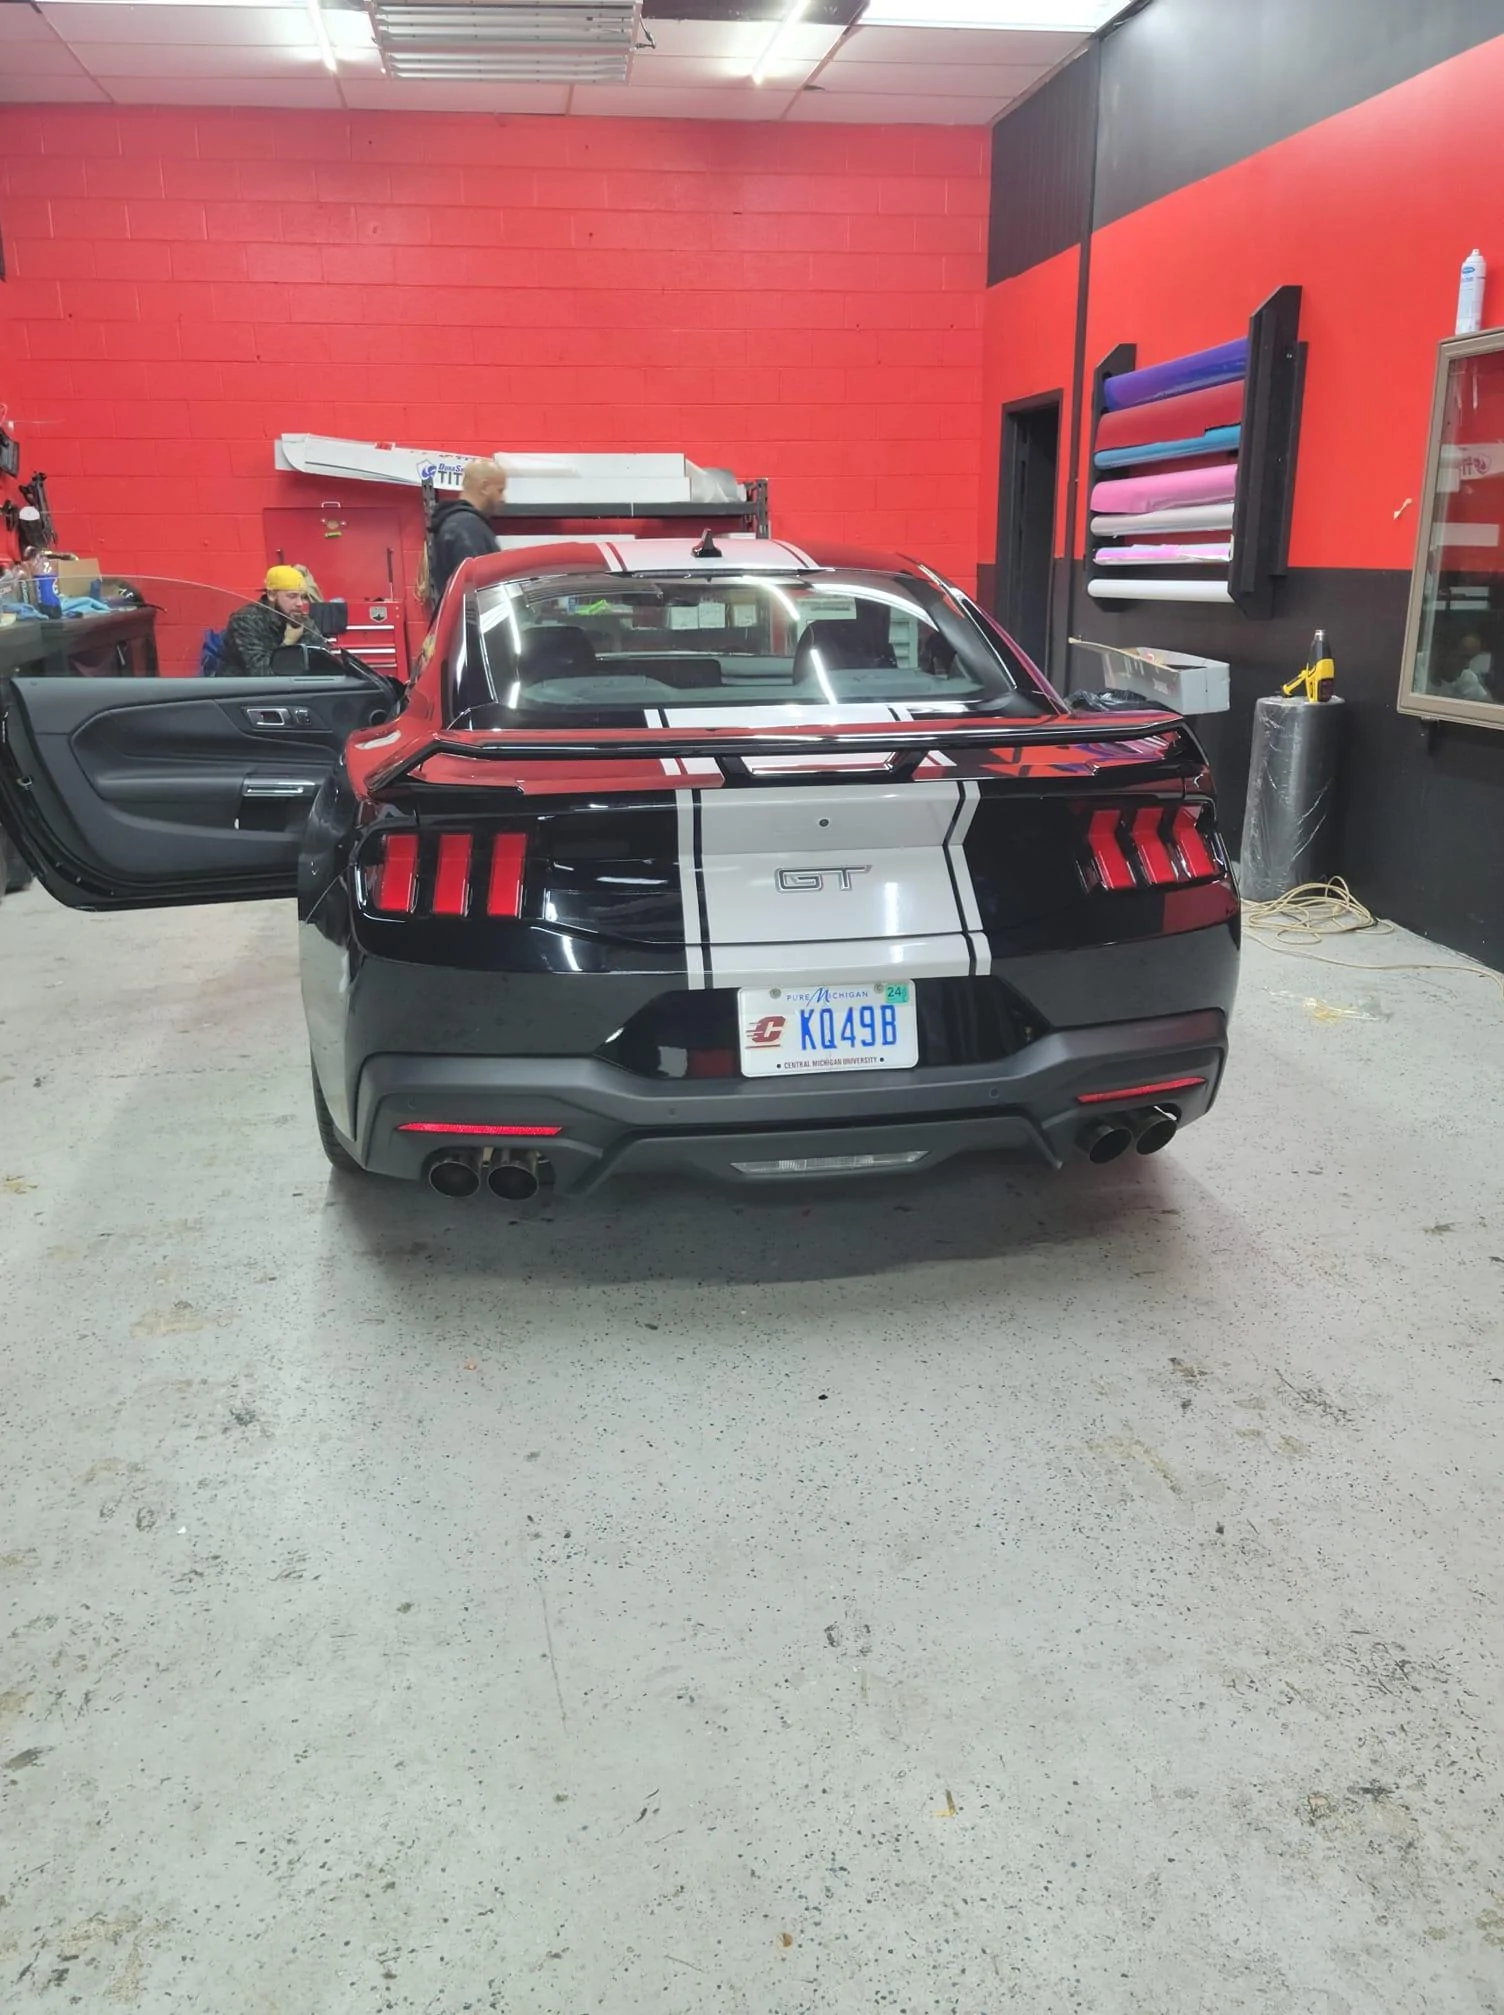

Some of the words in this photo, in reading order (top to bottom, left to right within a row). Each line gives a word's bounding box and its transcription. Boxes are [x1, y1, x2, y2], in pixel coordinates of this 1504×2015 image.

[438, 470, 462, 485] TIT
[775, 865, 873, 893] GT
[787, 994, 810, 1002] PURE
[806, 987, 869, 1006] MICHIGAN
[887, 986, 902, 998] 24
[800, 1004, 897, 1050] KQ49B
[784, 1060, 811, 1070] CENTRAL
[812, 1058, 842, 1067] MICHIGAN
[843, 1056, 878, 1066] UNIVERSITY
